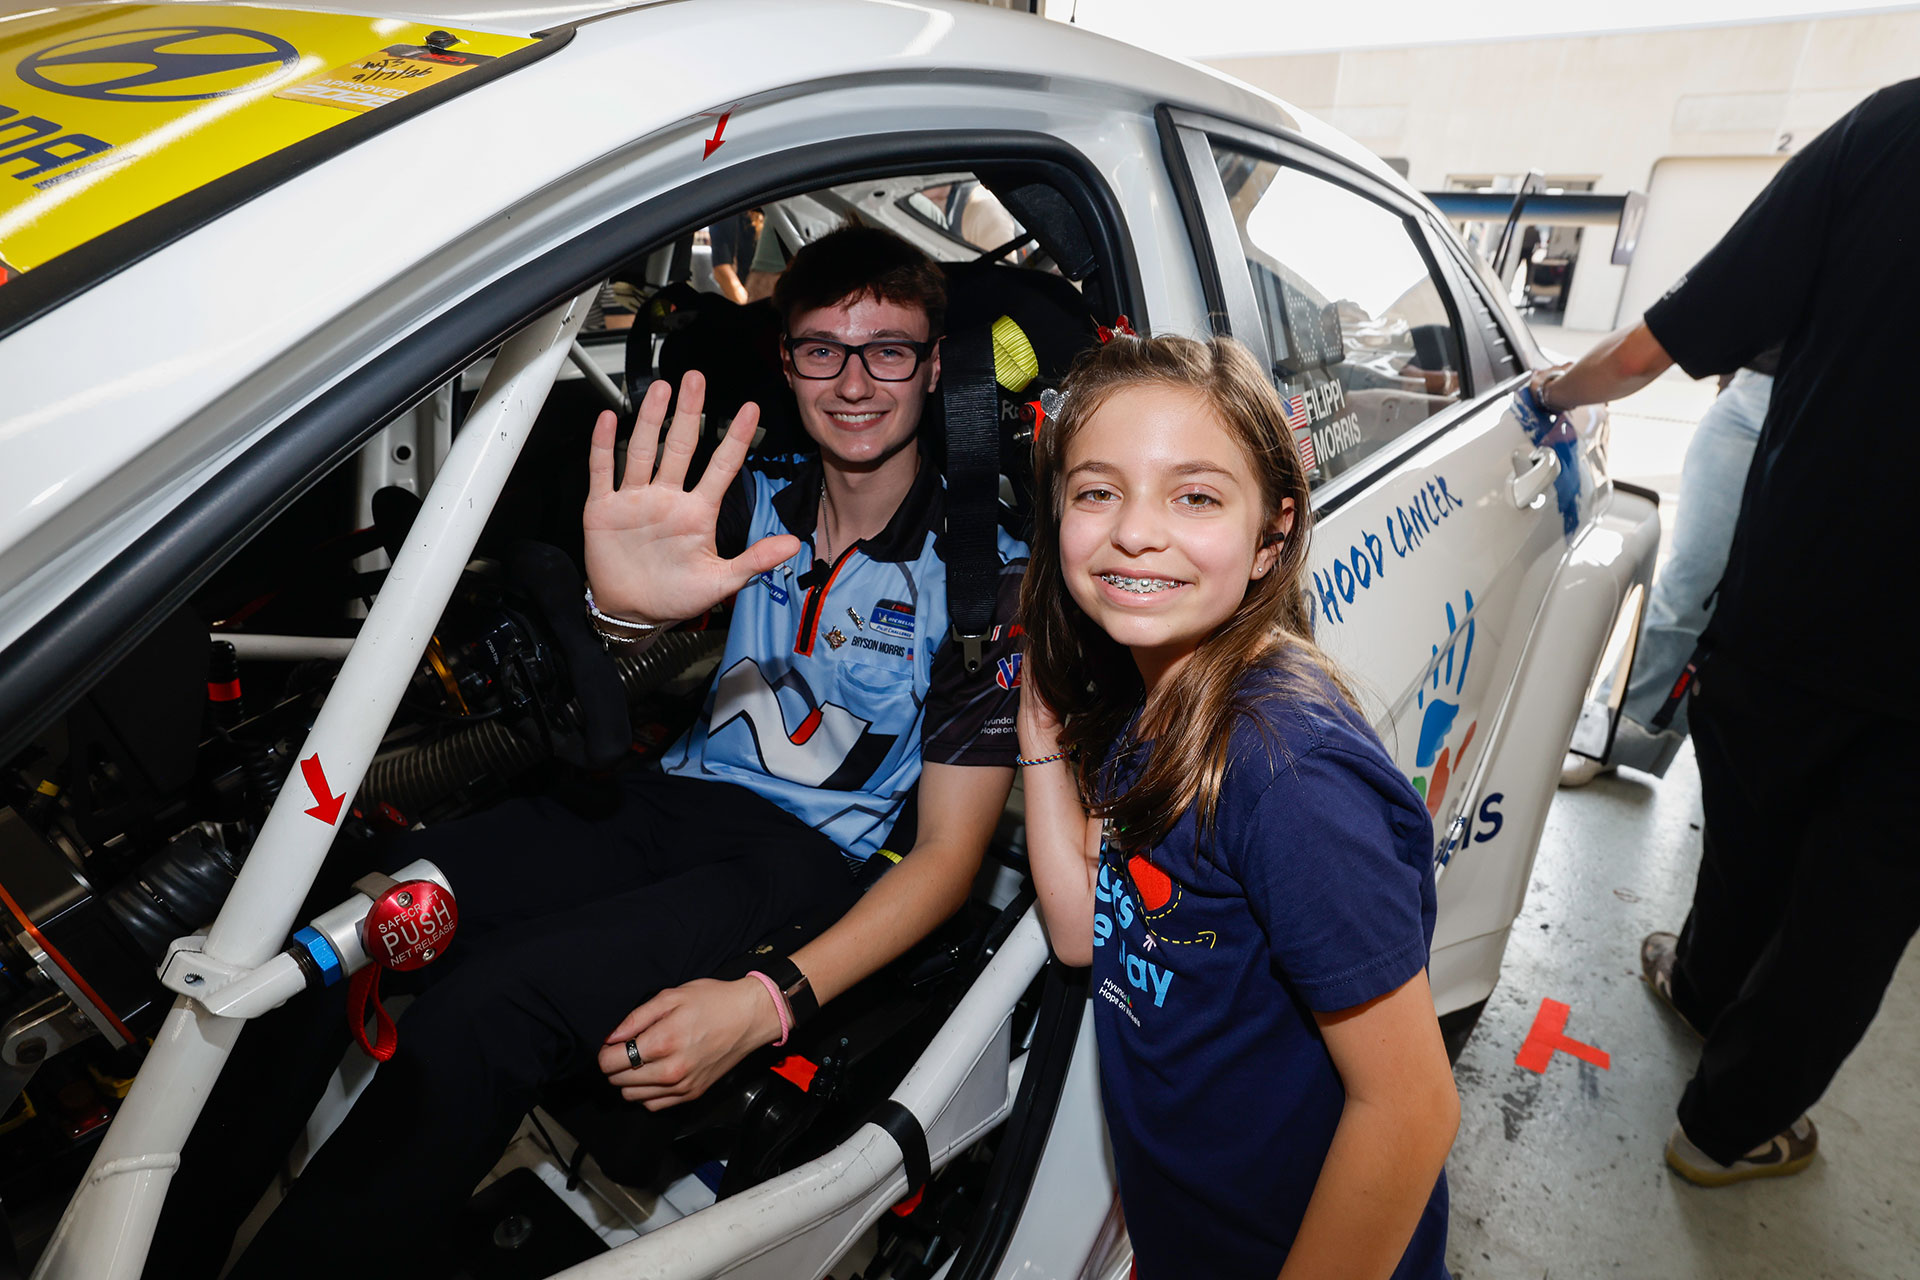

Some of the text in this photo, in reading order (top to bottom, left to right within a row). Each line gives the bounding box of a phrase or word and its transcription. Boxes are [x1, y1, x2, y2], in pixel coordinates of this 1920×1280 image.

[319, 78, 409, 97] APPROVED
[1777, 132, 1793, 151] 2
[1303, 378, 1346, 424] FILIPPI
[1313, 412, 1361, 465] MORRIS
[1386, 474, 1463, 558] CANCER
[851, 635, 906, 658] BRYSON MORRIS
[378, 889, 439, 933] SAFECRAFT
[382, 899, 451, 957] PUSH
[390, 919, 455, 967] NET RELEASE
[1098, 986, 1119, 1005] Hope
